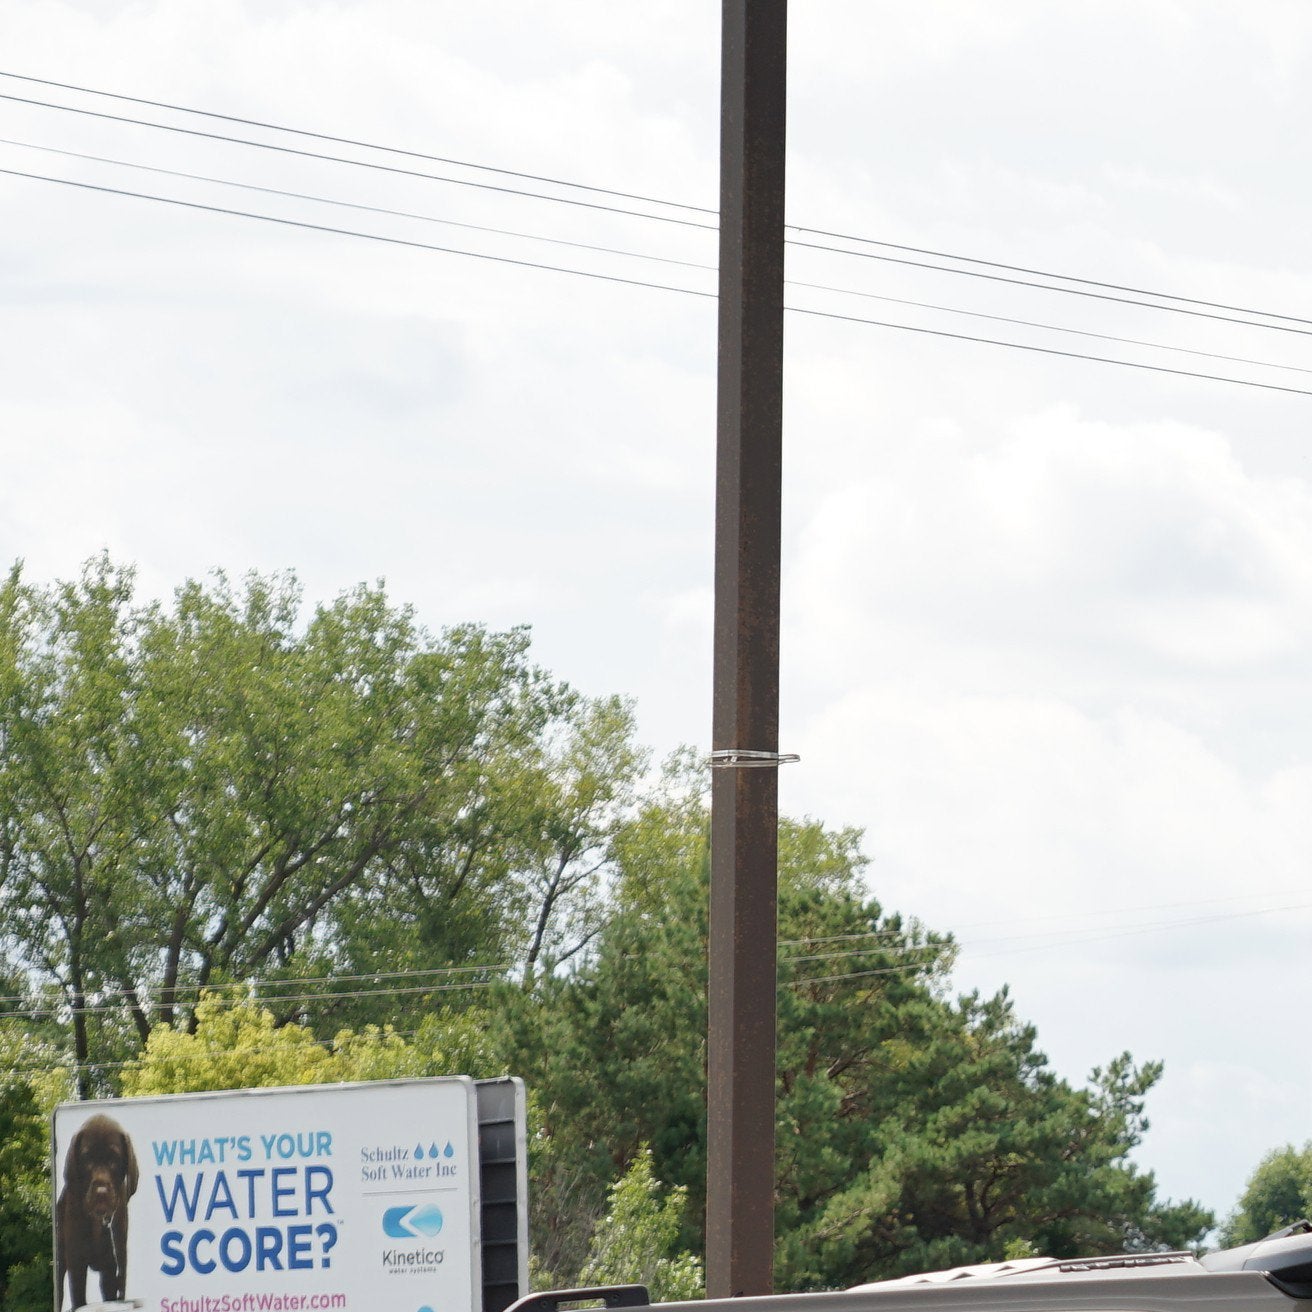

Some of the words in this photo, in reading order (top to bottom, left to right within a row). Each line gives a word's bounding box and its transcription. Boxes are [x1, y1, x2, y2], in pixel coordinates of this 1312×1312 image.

[152, 1136, 252, 1166] WHAT'S
[260, 1131, 332, 1160] YOUR
[361, 1146, 409, 1163] Schultz
[361, 1164, 387, 1182] Soft
[391, 1163, 432, 1180] Water
[436, 1162, 457, 1177] Inc
[155, 1165, 335, 1223] WATER
[160, 1223, 338, 1276] SCORE?
[382, 1248, 444, 1267] Kinetico
